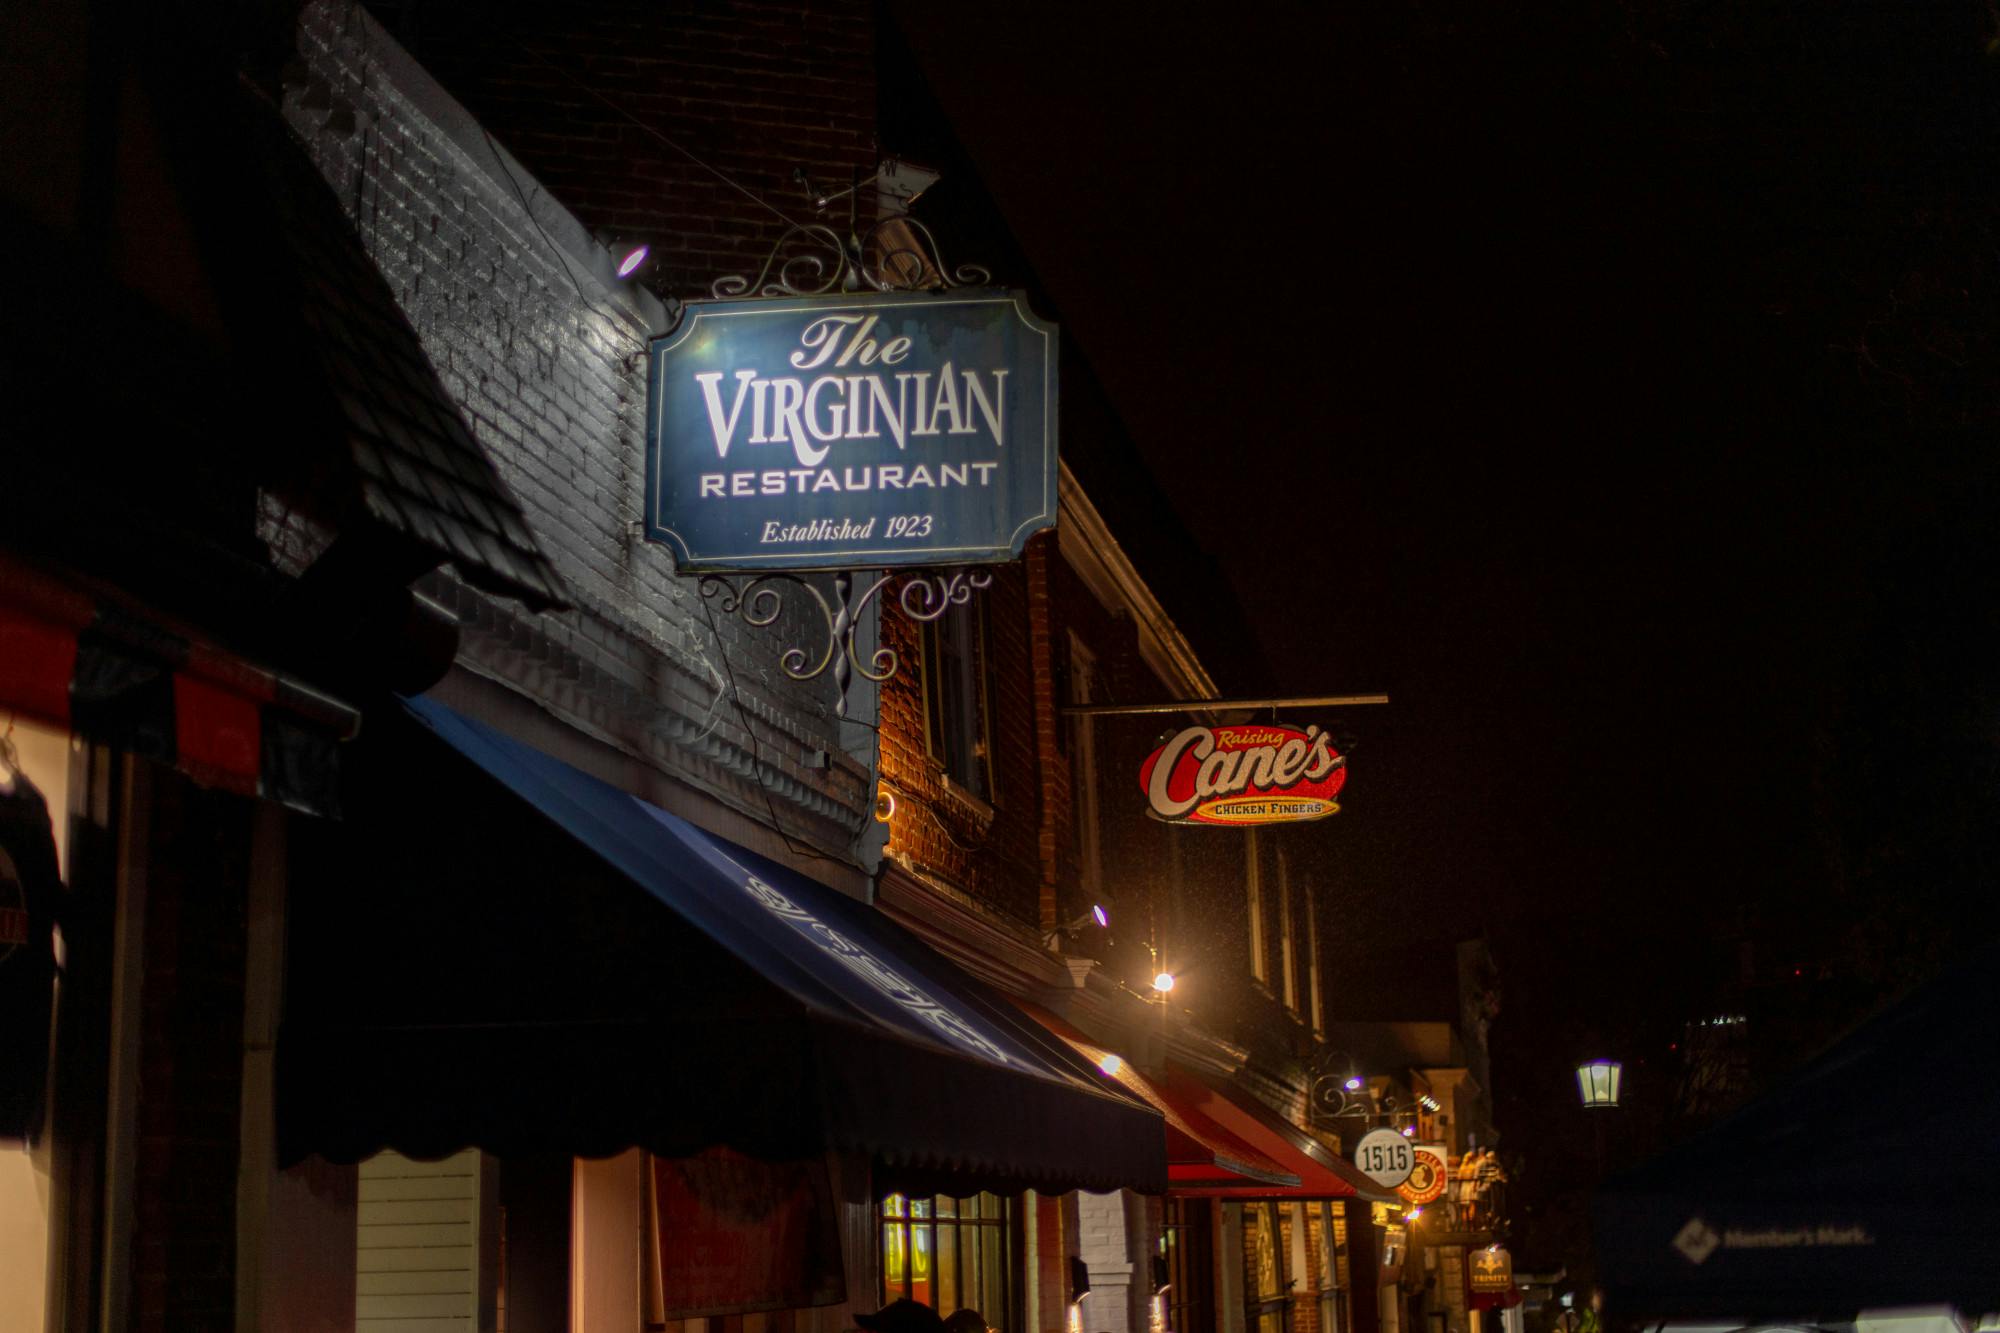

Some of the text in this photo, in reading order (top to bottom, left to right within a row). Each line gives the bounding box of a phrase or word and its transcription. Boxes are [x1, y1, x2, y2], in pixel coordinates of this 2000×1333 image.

[789, 313, 914, 369] The
[696, 361, 1009, 467] VIRGINIAN
[701, 462, 998, 498] RESTAURANT
[760, 515, 933, 544] Established 1923
[1217, 729, 1285, 749] Raising
[1149, 725, 1346, 816] Cane's
[1215, 802, 1322, 815] CHICKEN FINGERS
